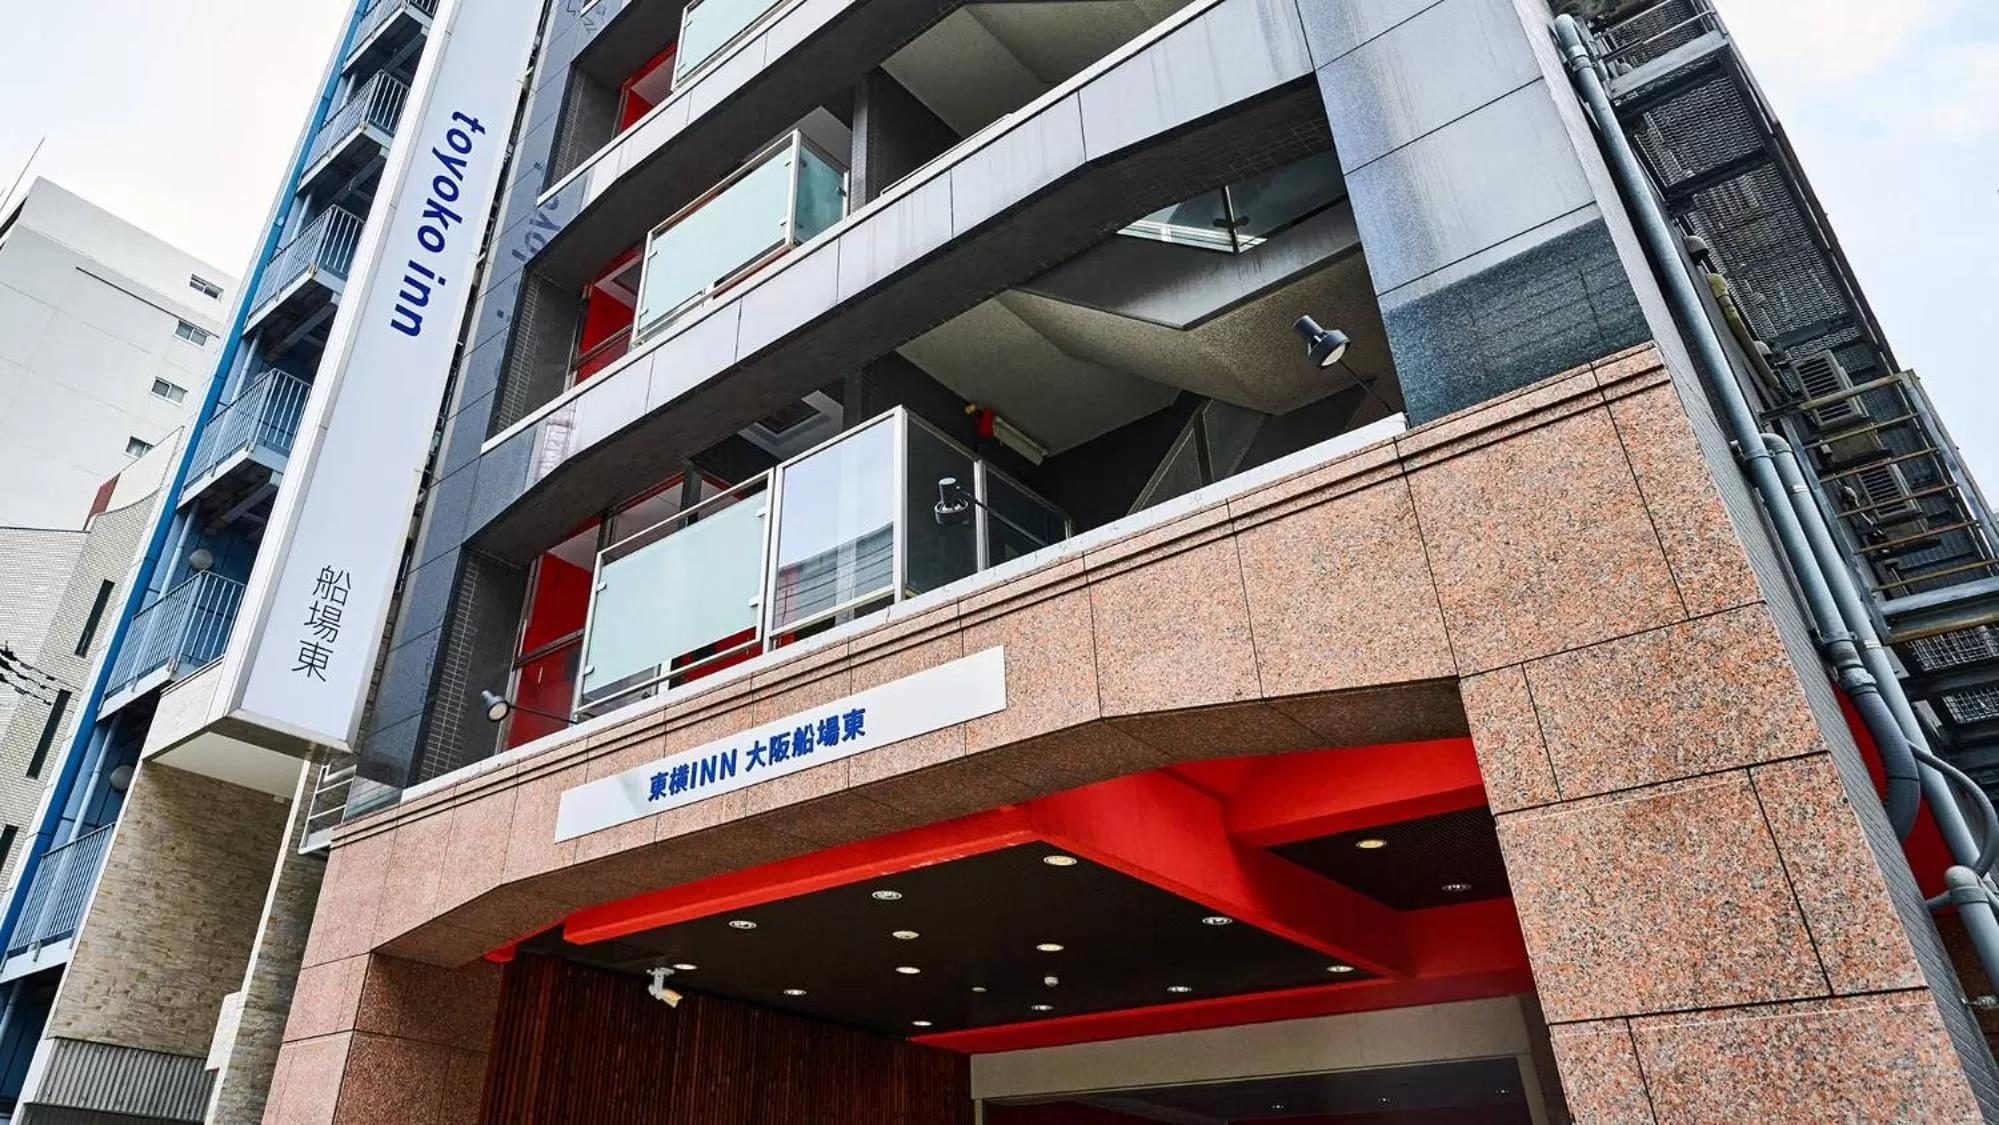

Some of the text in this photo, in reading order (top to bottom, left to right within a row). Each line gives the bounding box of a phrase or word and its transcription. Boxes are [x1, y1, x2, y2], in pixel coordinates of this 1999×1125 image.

[390, 111, 486, 338] toyoko inn
[291, 564, 352, 683] 船場東
[648, 708, 866, 801] 東横INN 大阪船場東
